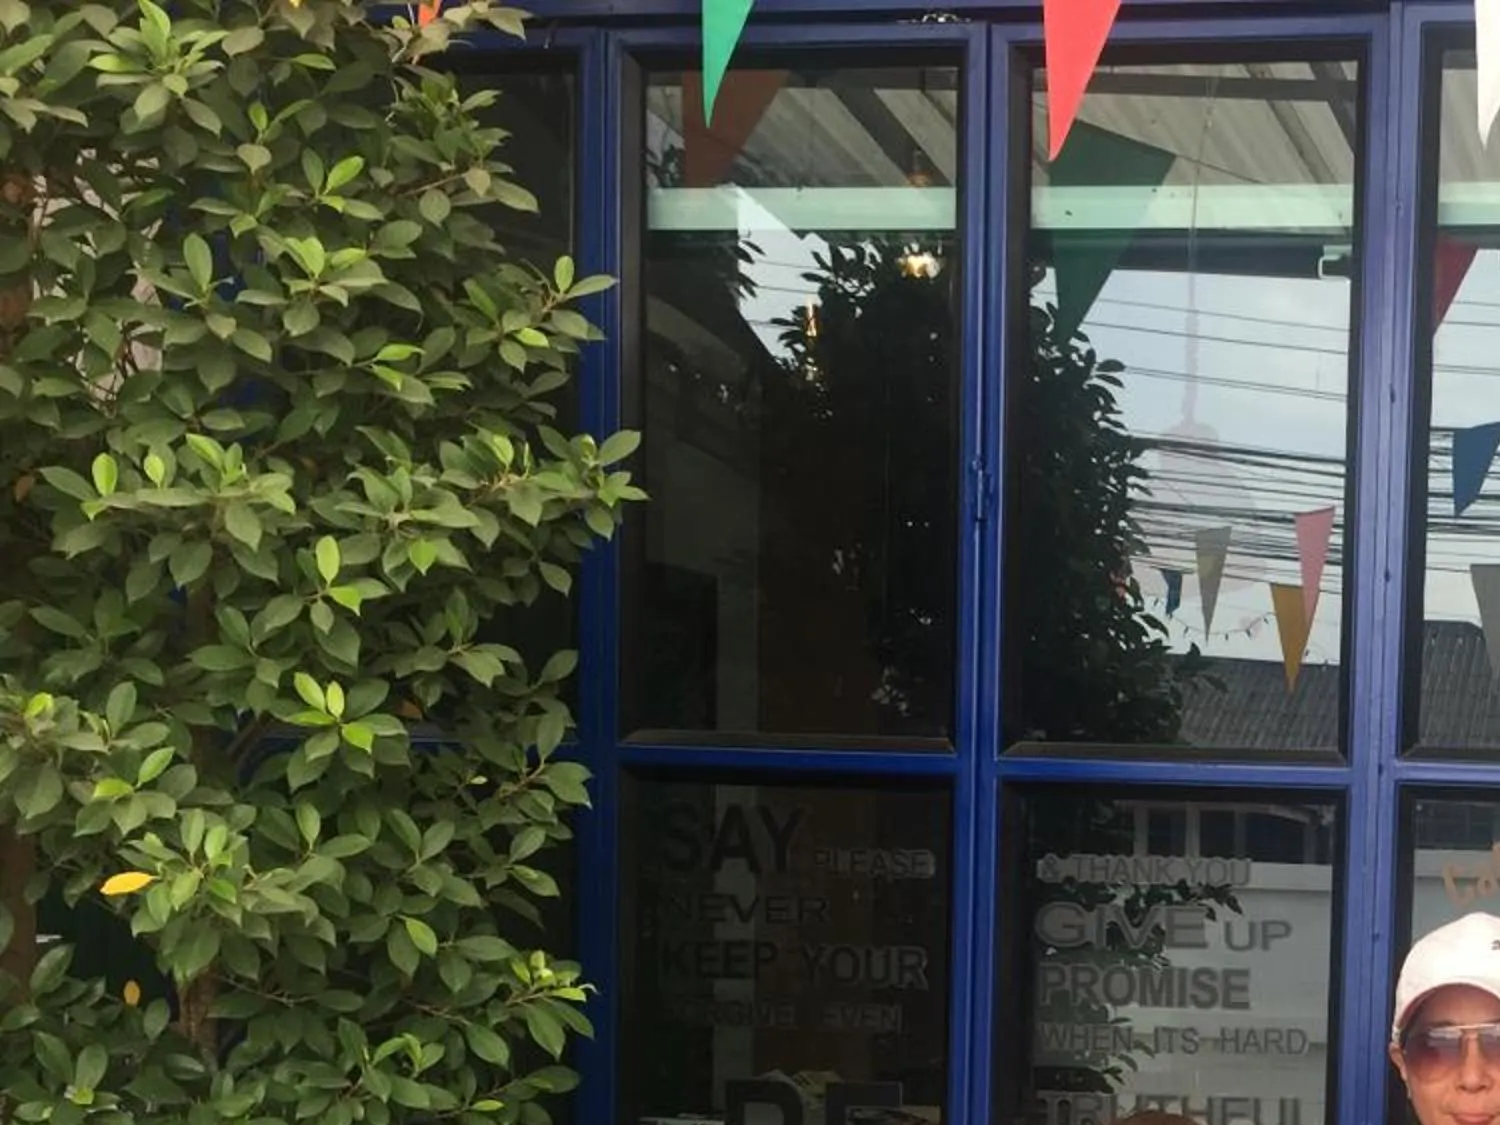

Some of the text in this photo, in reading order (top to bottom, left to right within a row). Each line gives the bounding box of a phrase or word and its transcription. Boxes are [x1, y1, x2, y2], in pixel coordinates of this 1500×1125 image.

[663, 803, 936, 880] SAY PLEASE
[1038, 856, 1251, 887] & THANK YOU
[665, 891, 833, 926] NEVER
[1035, 903, 1294, 952] GIVE UP
[661, 940, 930, 990] KEEP YOUR
[1039, 965, 1251, 1010] PROMISE
[1038, 1025, 1309, 1056] WHEN ITS HARD
